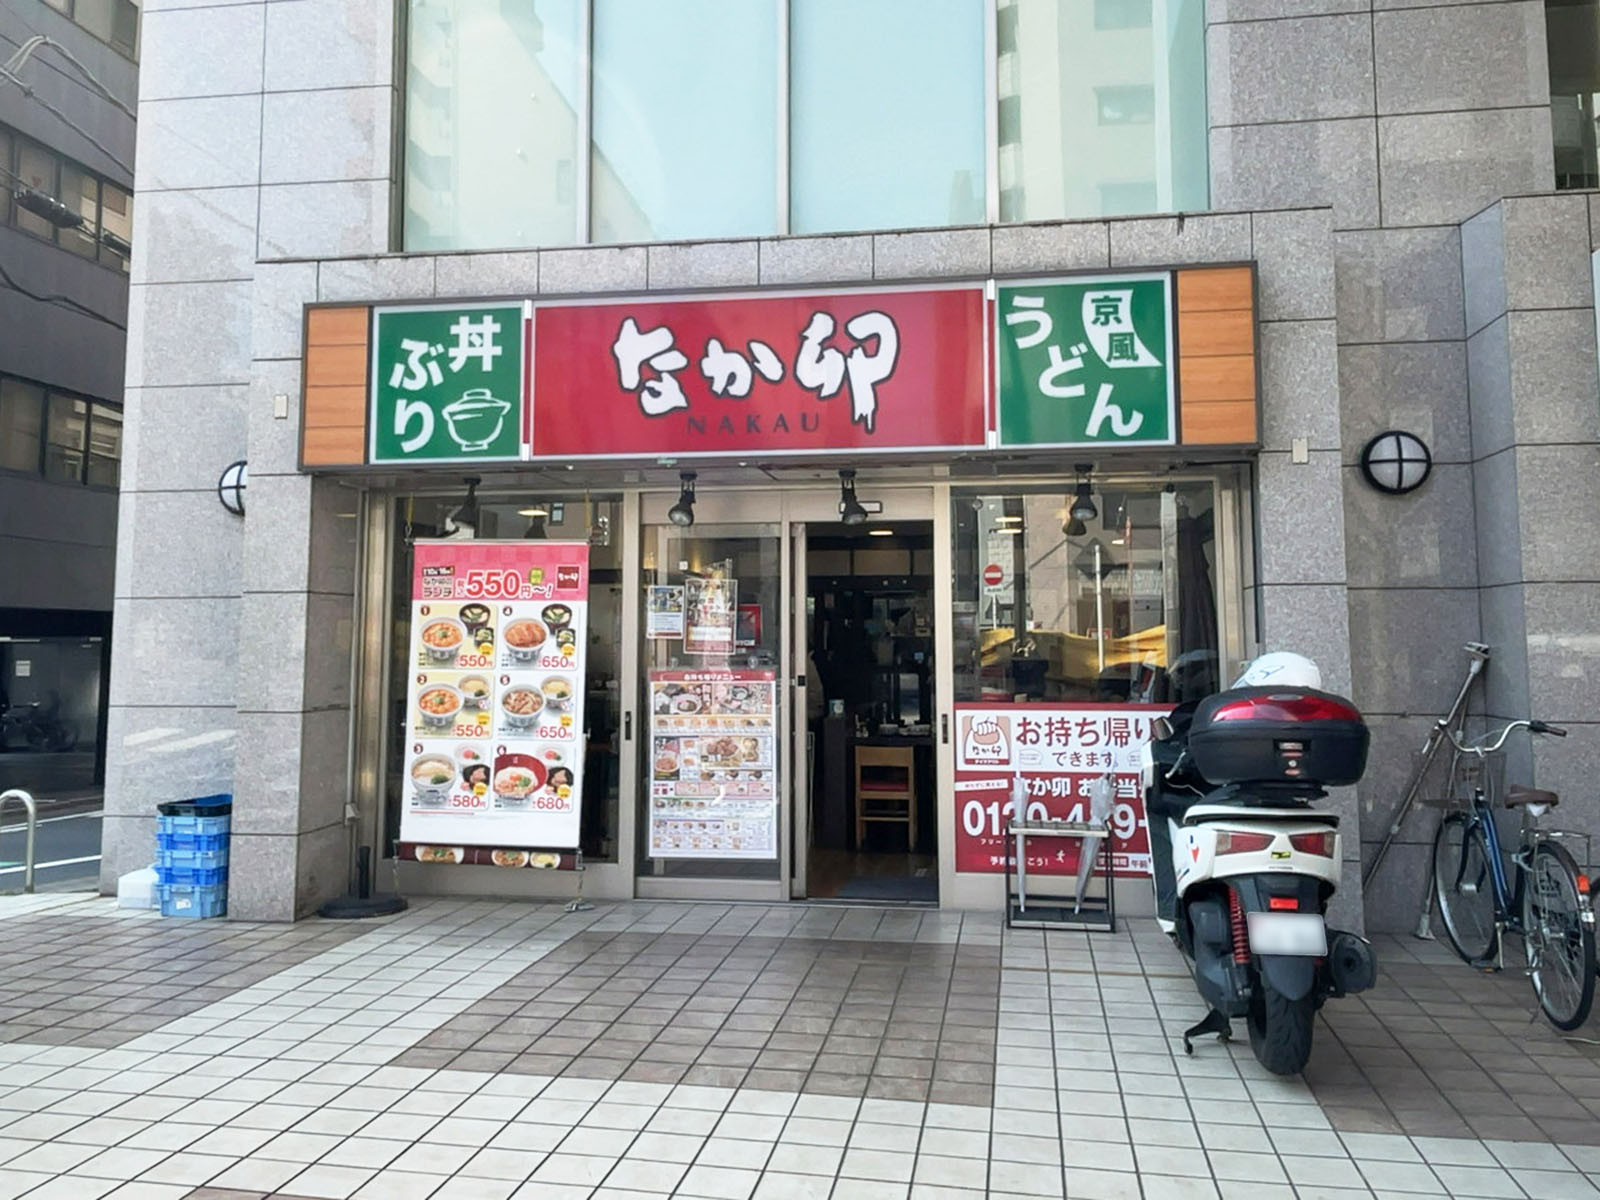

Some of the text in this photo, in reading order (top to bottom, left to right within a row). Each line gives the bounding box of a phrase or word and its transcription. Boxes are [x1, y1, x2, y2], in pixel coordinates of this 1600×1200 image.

[1090, 295, 1140, 363] 京風
[388, 314, 502, 453] 丼ぶり
[612, 310, 900, 434] なか卯
[1005, 295, 1144, 438] うどん
[687, 411, 820, 434] NAKAU
[1016, 716, 1153, 747] お持ち帰り
[1052, 751, 1113, 768] できます
